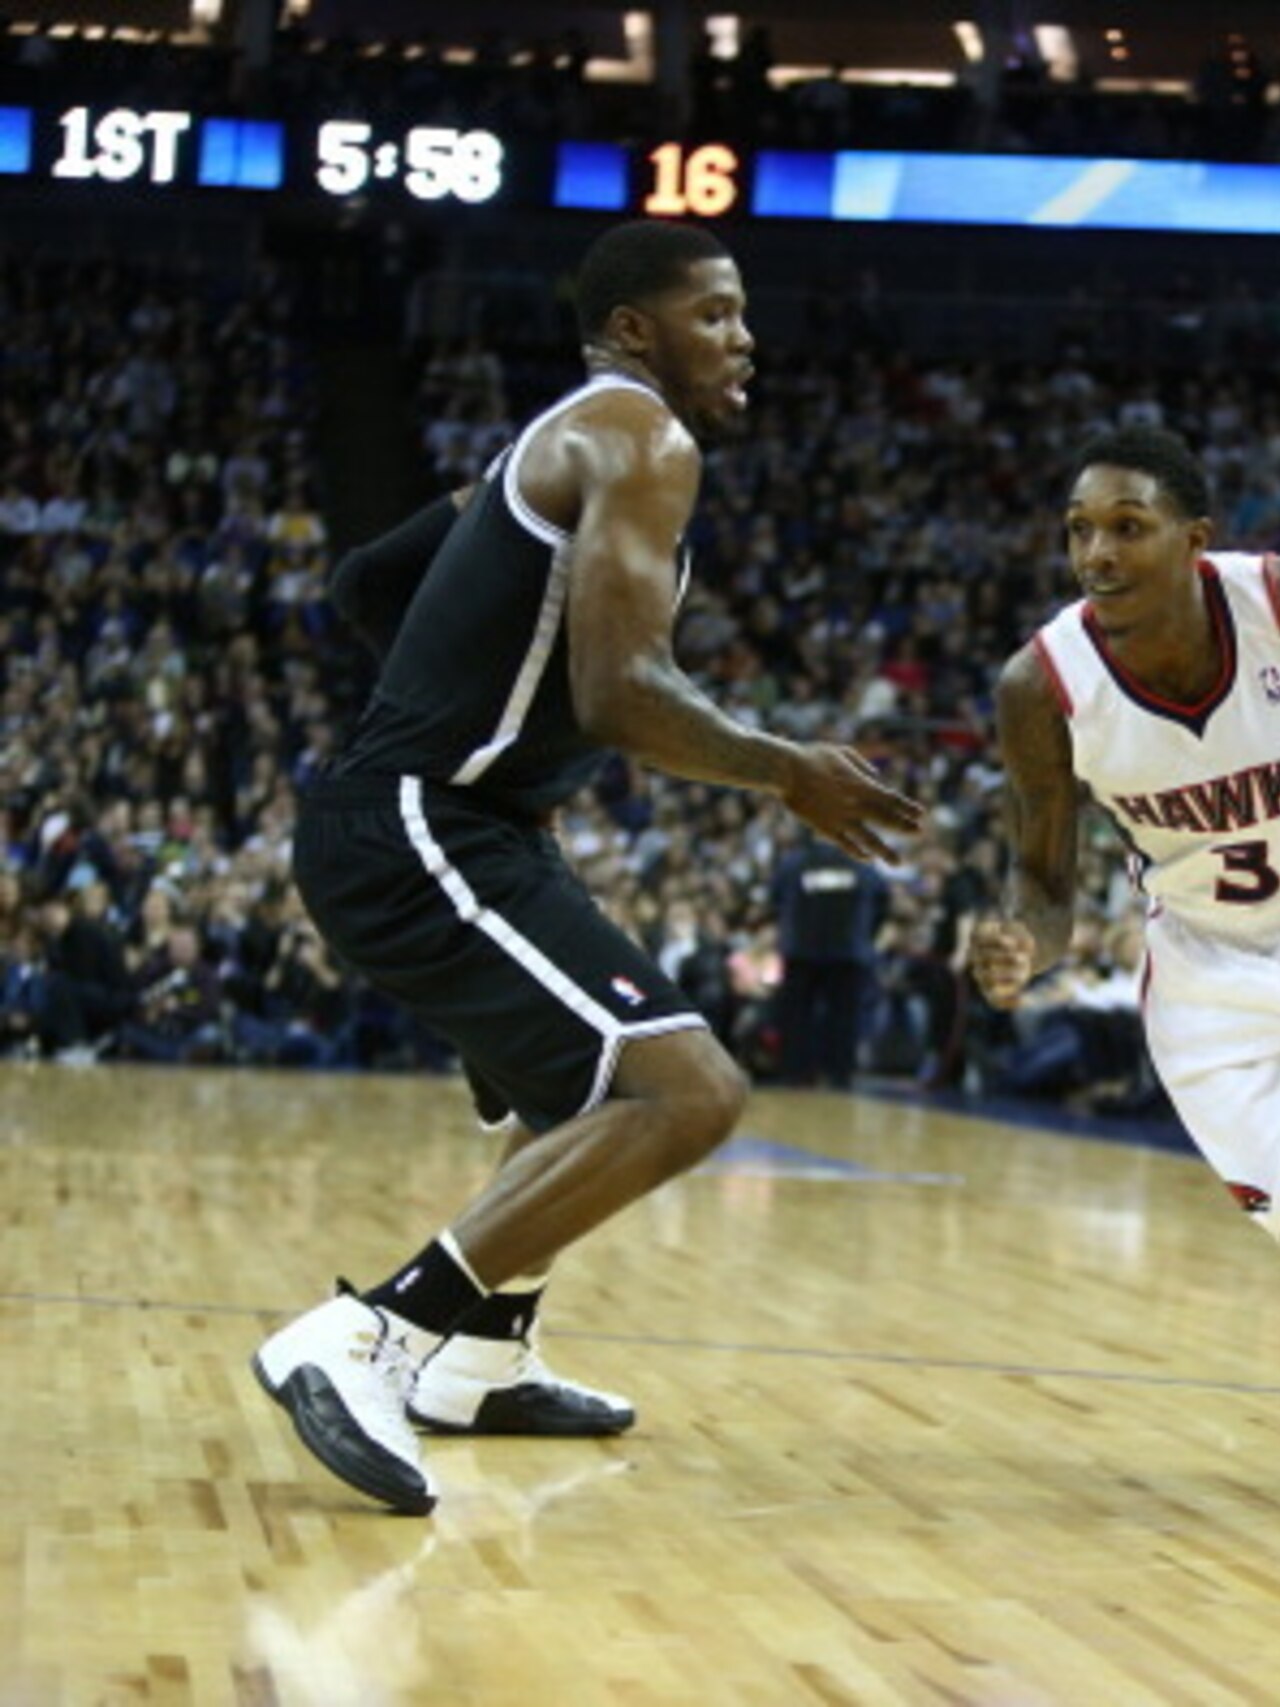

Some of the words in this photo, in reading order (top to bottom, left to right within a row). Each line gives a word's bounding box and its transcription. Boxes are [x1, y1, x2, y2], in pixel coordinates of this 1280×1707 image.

[53, 107, 191, 182] 1ST
[316, 121, 503, 203] 5:58
[645, 143, 737, 216] 16
[1210, 839, 1280, 905] 3
